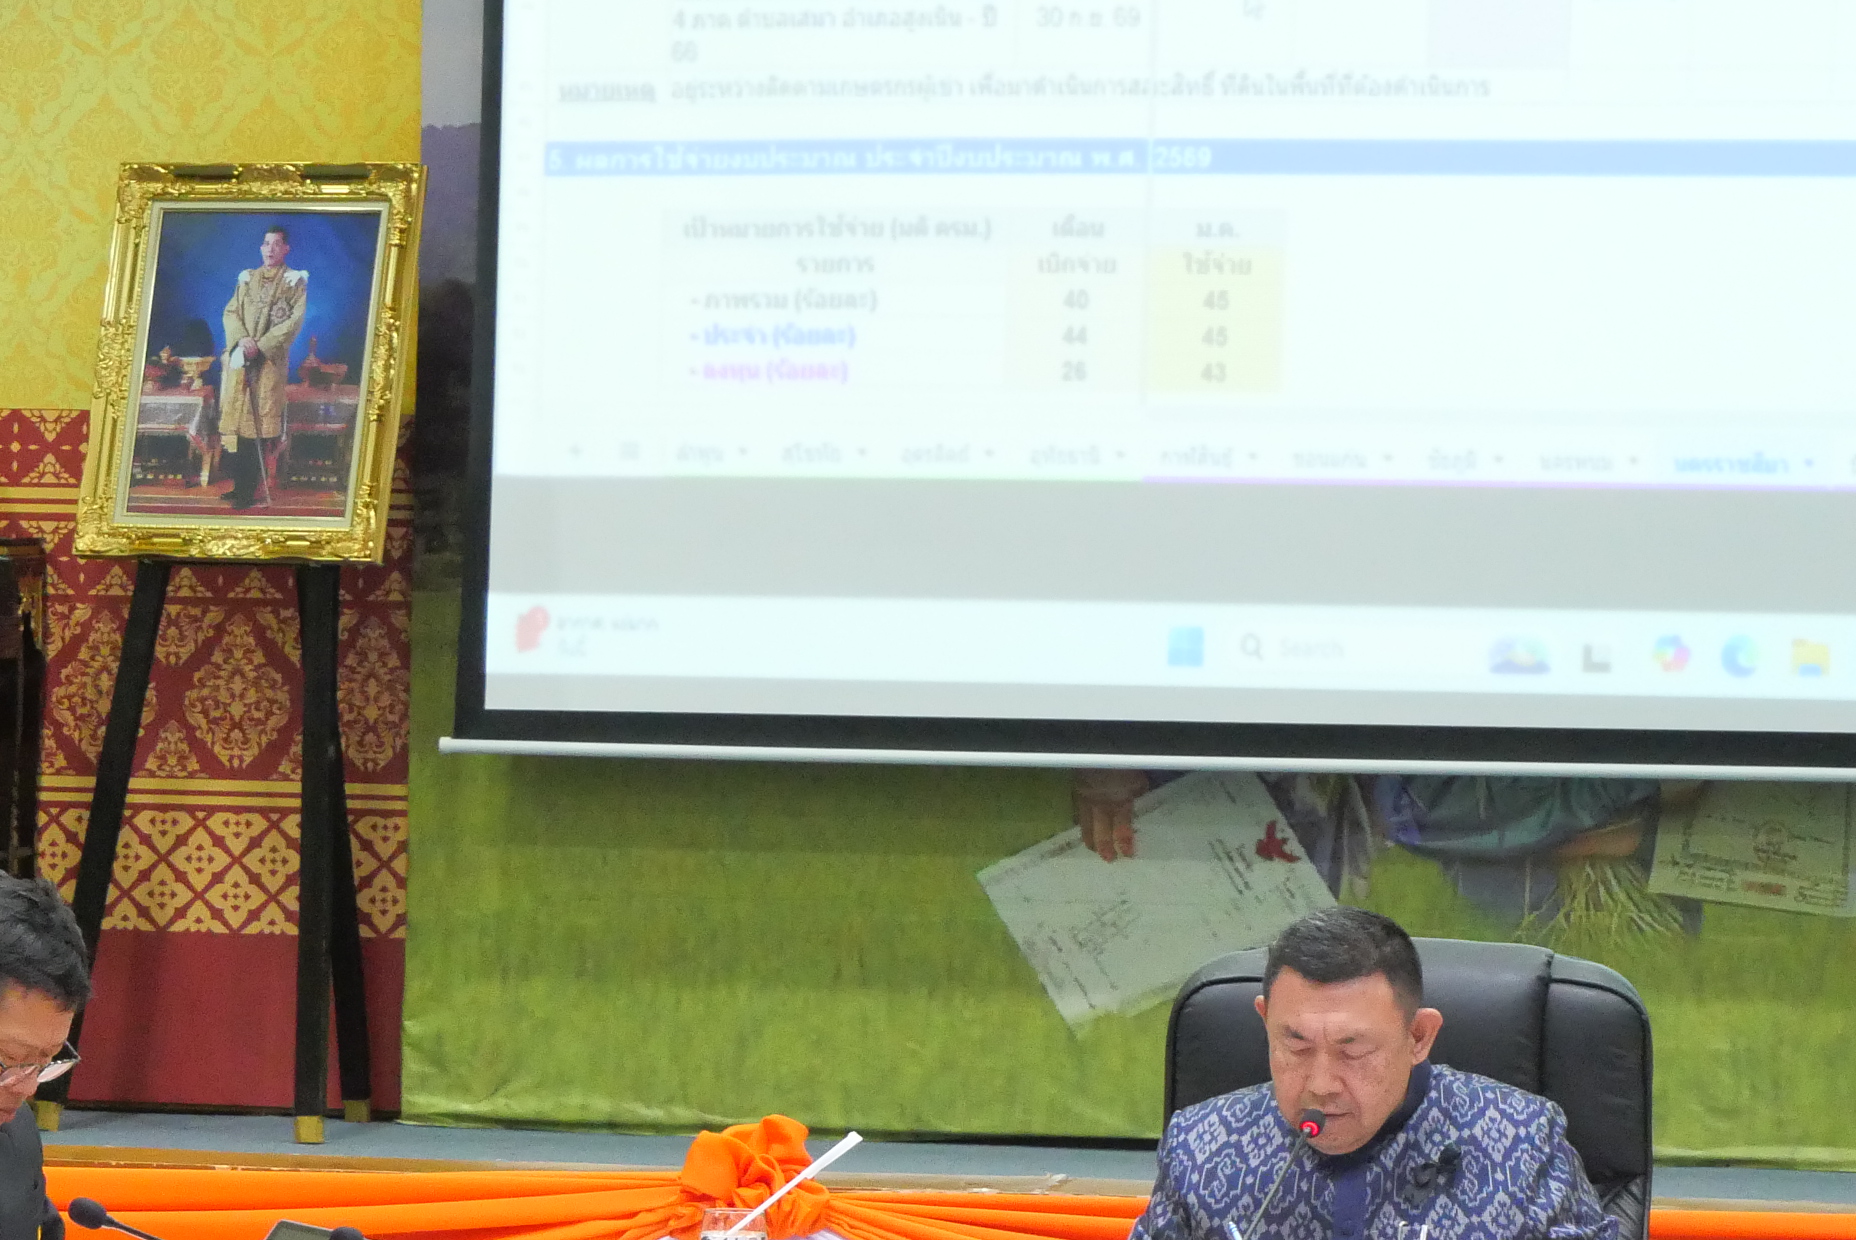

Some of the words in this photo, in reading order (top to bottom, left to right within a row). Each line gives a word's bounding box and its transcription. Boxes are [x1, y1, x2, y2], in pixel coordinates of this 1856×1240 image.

[1062, 289, 1090, 310] 40
[1062, 325, 1088, 346] 44
[1279, 636, 1346, 660] Search
